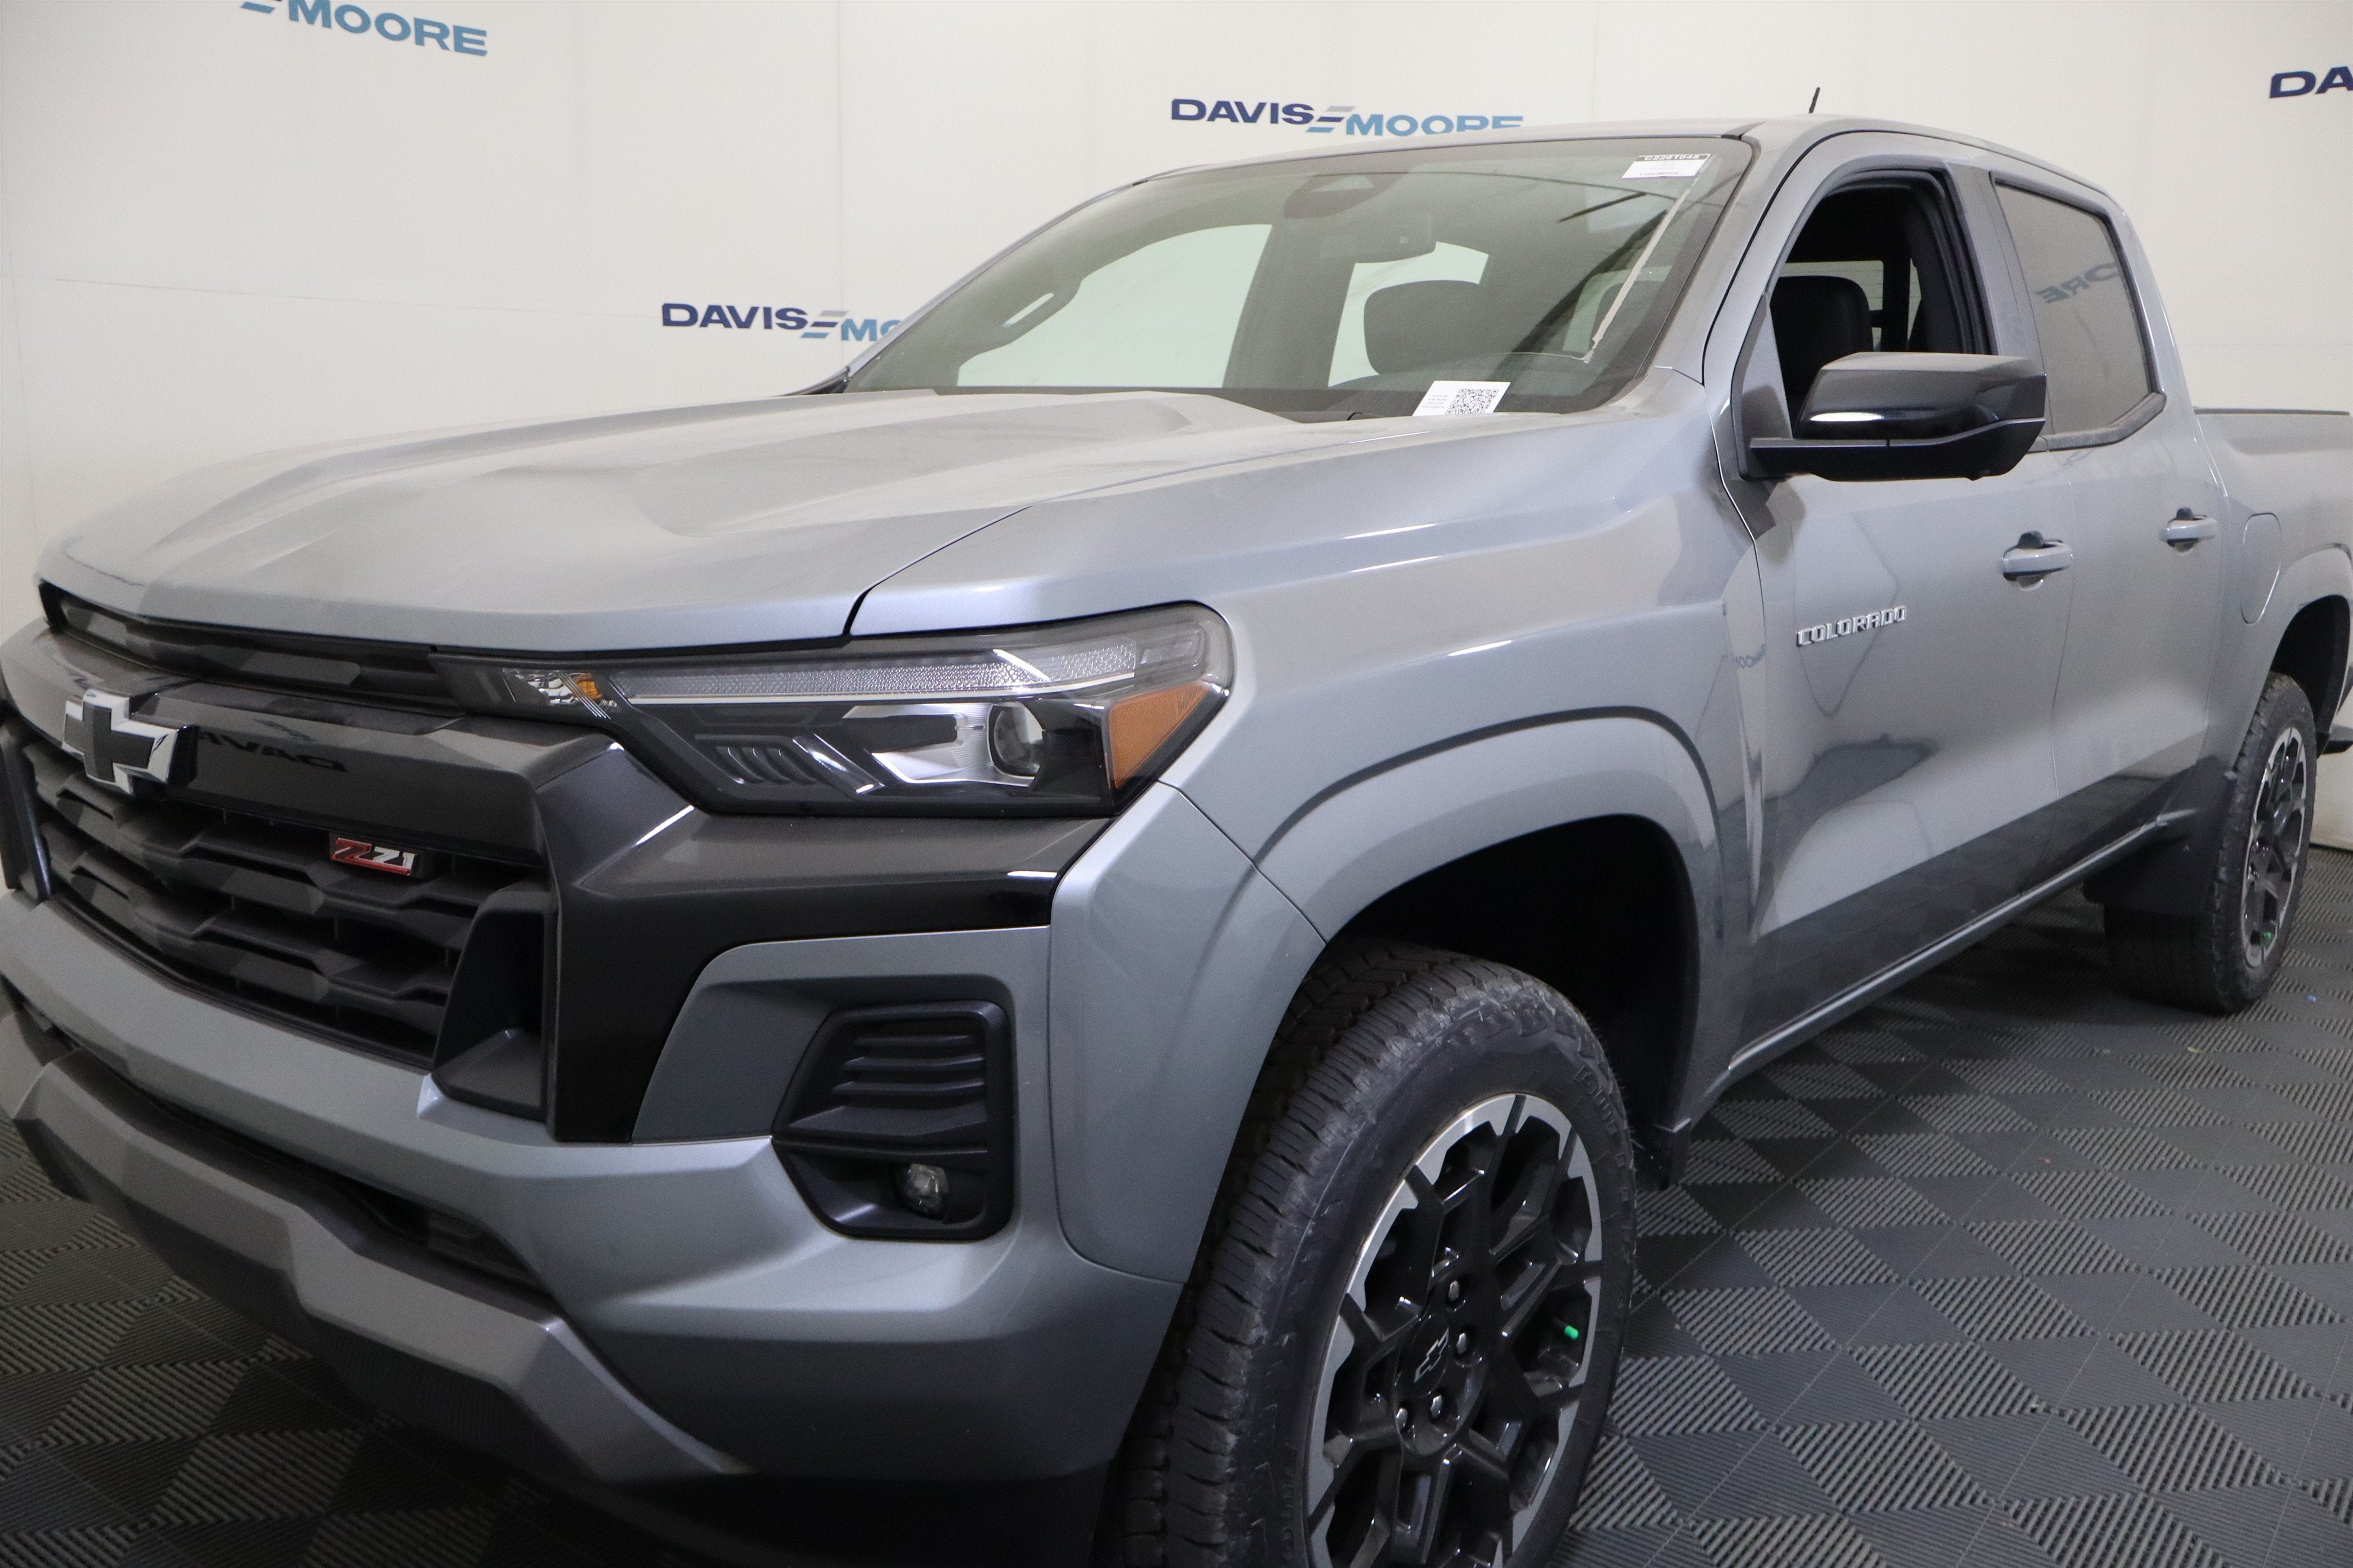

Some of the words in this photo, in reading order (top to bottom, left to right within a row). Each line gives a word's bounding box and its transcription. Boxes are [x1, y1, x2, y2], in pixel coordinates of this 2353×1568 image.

[287, 0, 488, 56] MOORE
[1171, 98, 1314, 125] DAVIS
[662, 303, 808, 330] DAVIS
[1796, 605, 1907, 647] COLORADO
[331, 837, 418, 875] Z71
